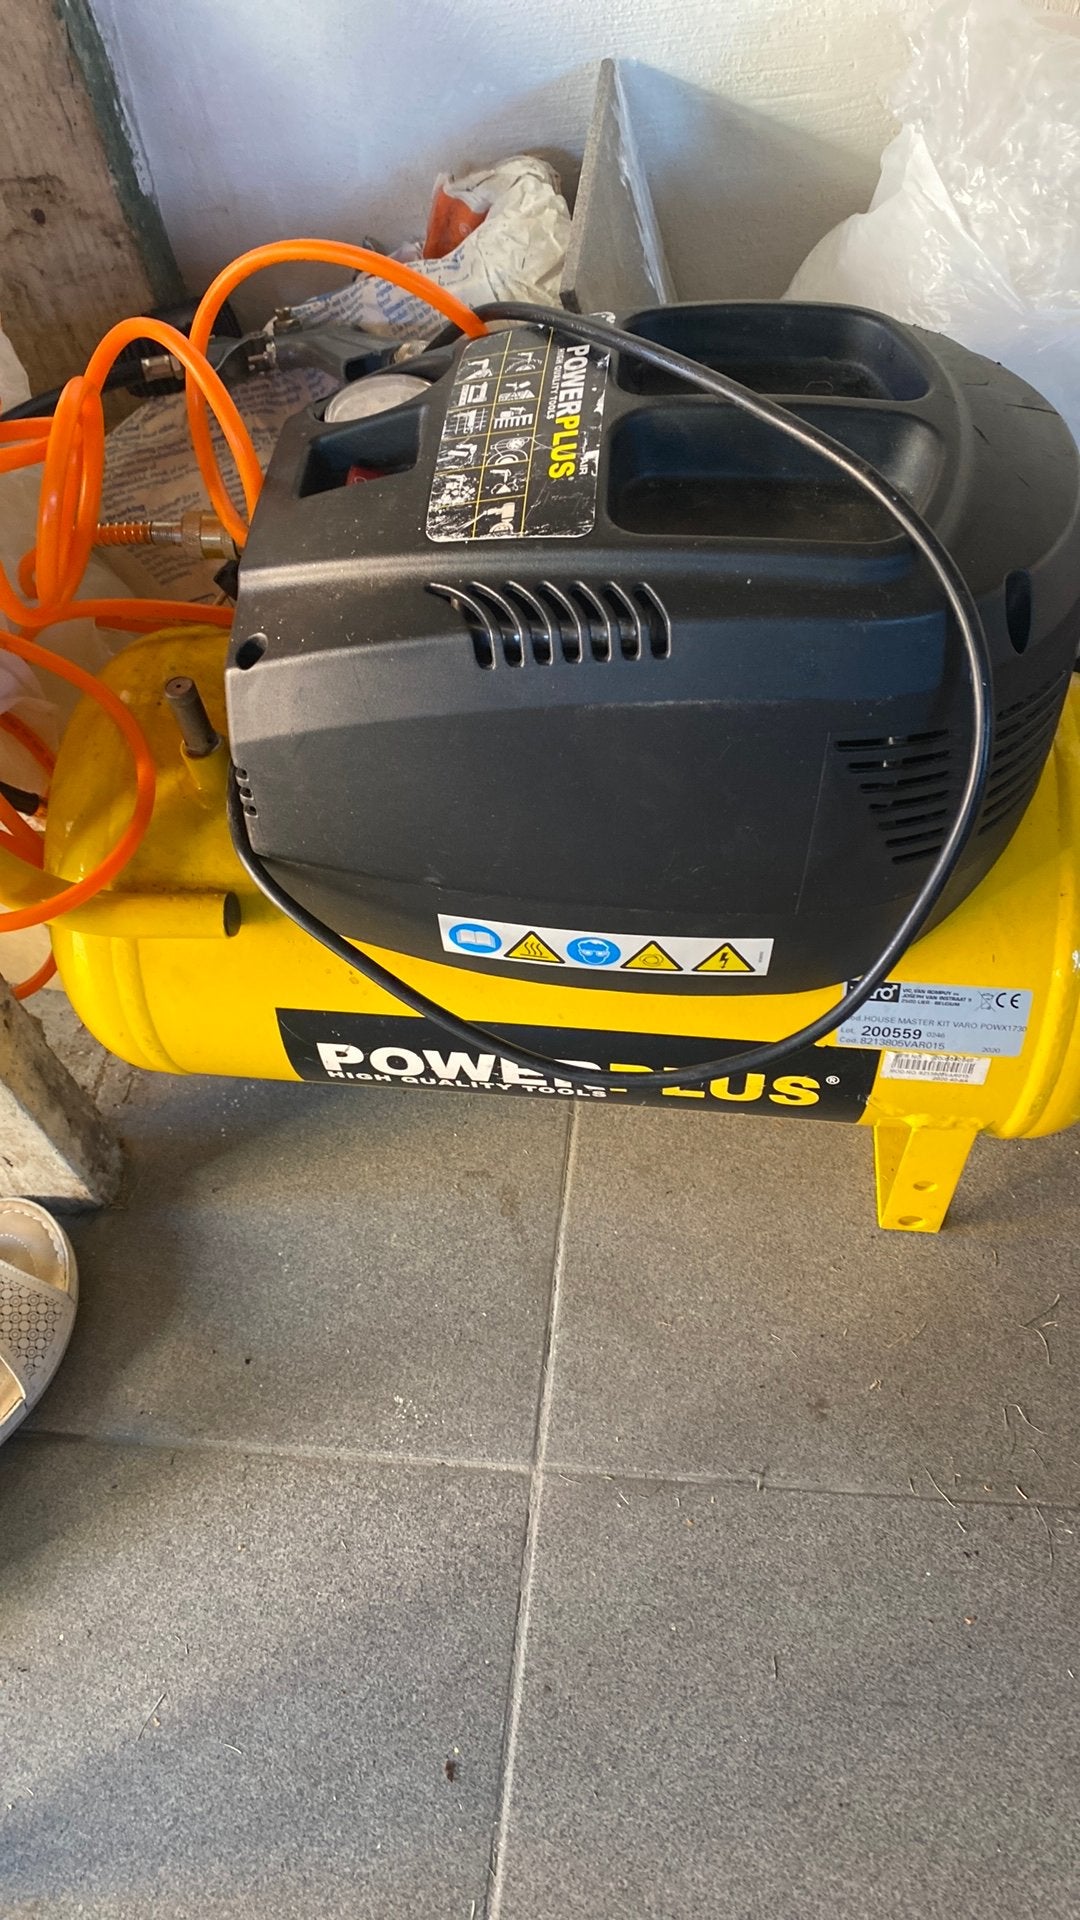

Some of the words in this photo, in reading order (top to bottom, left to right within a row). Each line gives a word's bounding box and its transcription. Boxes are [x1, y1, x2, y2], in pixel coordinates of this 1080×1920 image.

[550, 365, 562, 394] QUALITY
[546, 395, 557, 420] TOOLS
[548, 344, 590, 478] POWERPLUS
[861, 1025, 923, 1040] 200559
[898, 1017, 936, 1026] MASTER
[937, 1019, 950, 1027] KIT
[953, 1021, 977, 1029] VARO
[327, 1070, 392, 1082] HIGH
[400, 1076, 512, 1090] QUALITY
[521, 1085, 607, 1098] TOOLS
